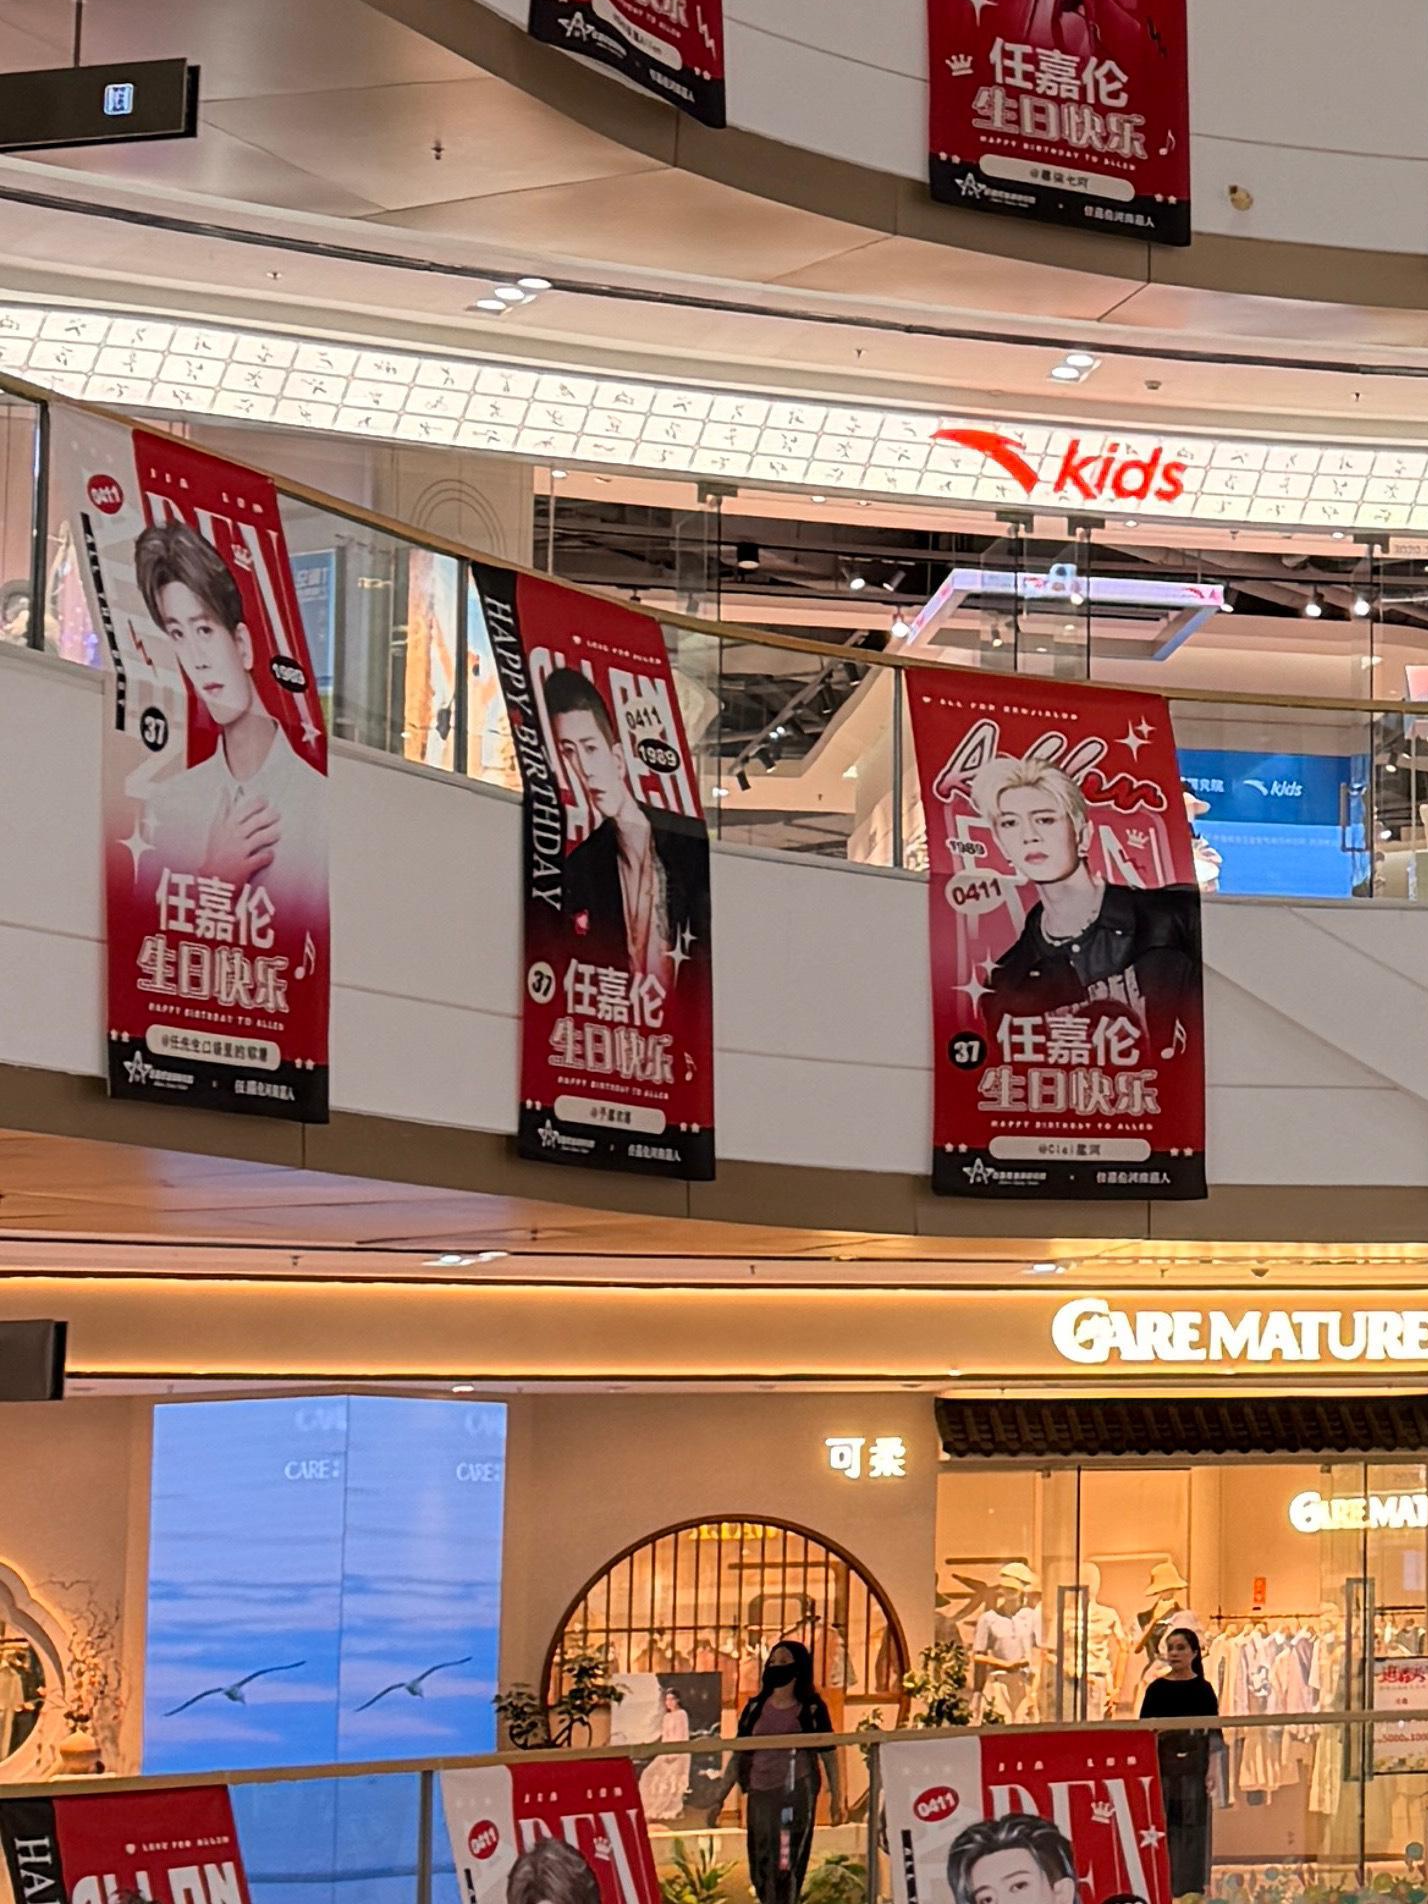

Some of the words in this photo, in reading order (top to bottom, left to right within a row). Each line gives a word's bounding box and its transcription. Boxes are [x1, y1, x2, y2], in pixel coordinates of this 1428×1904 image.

[989, 38, 1130, 109] 任嘉伦
[972, 87, 1149, 160] 生日快乐
[1053, 438, 1184, 503] kids
[1271, 779, 1303, 797] kids
[156, 868, 276, 948] 任嘉伦
[953, 882, 1001, 906] 0411
[139, 933, 288, 1013] 生日快乐
[564, 959, 664, 1028] 任嘉伦
[549, 1020, 672, 1085] 生日快乐
[997, 1015, 1141, 1067] 任嘉伦
[977, 1070, 1161, 1117] 生日快乐
[825, 1437, 906, 1479] 可柔
[917, 1792, 957, 1818] 0411
